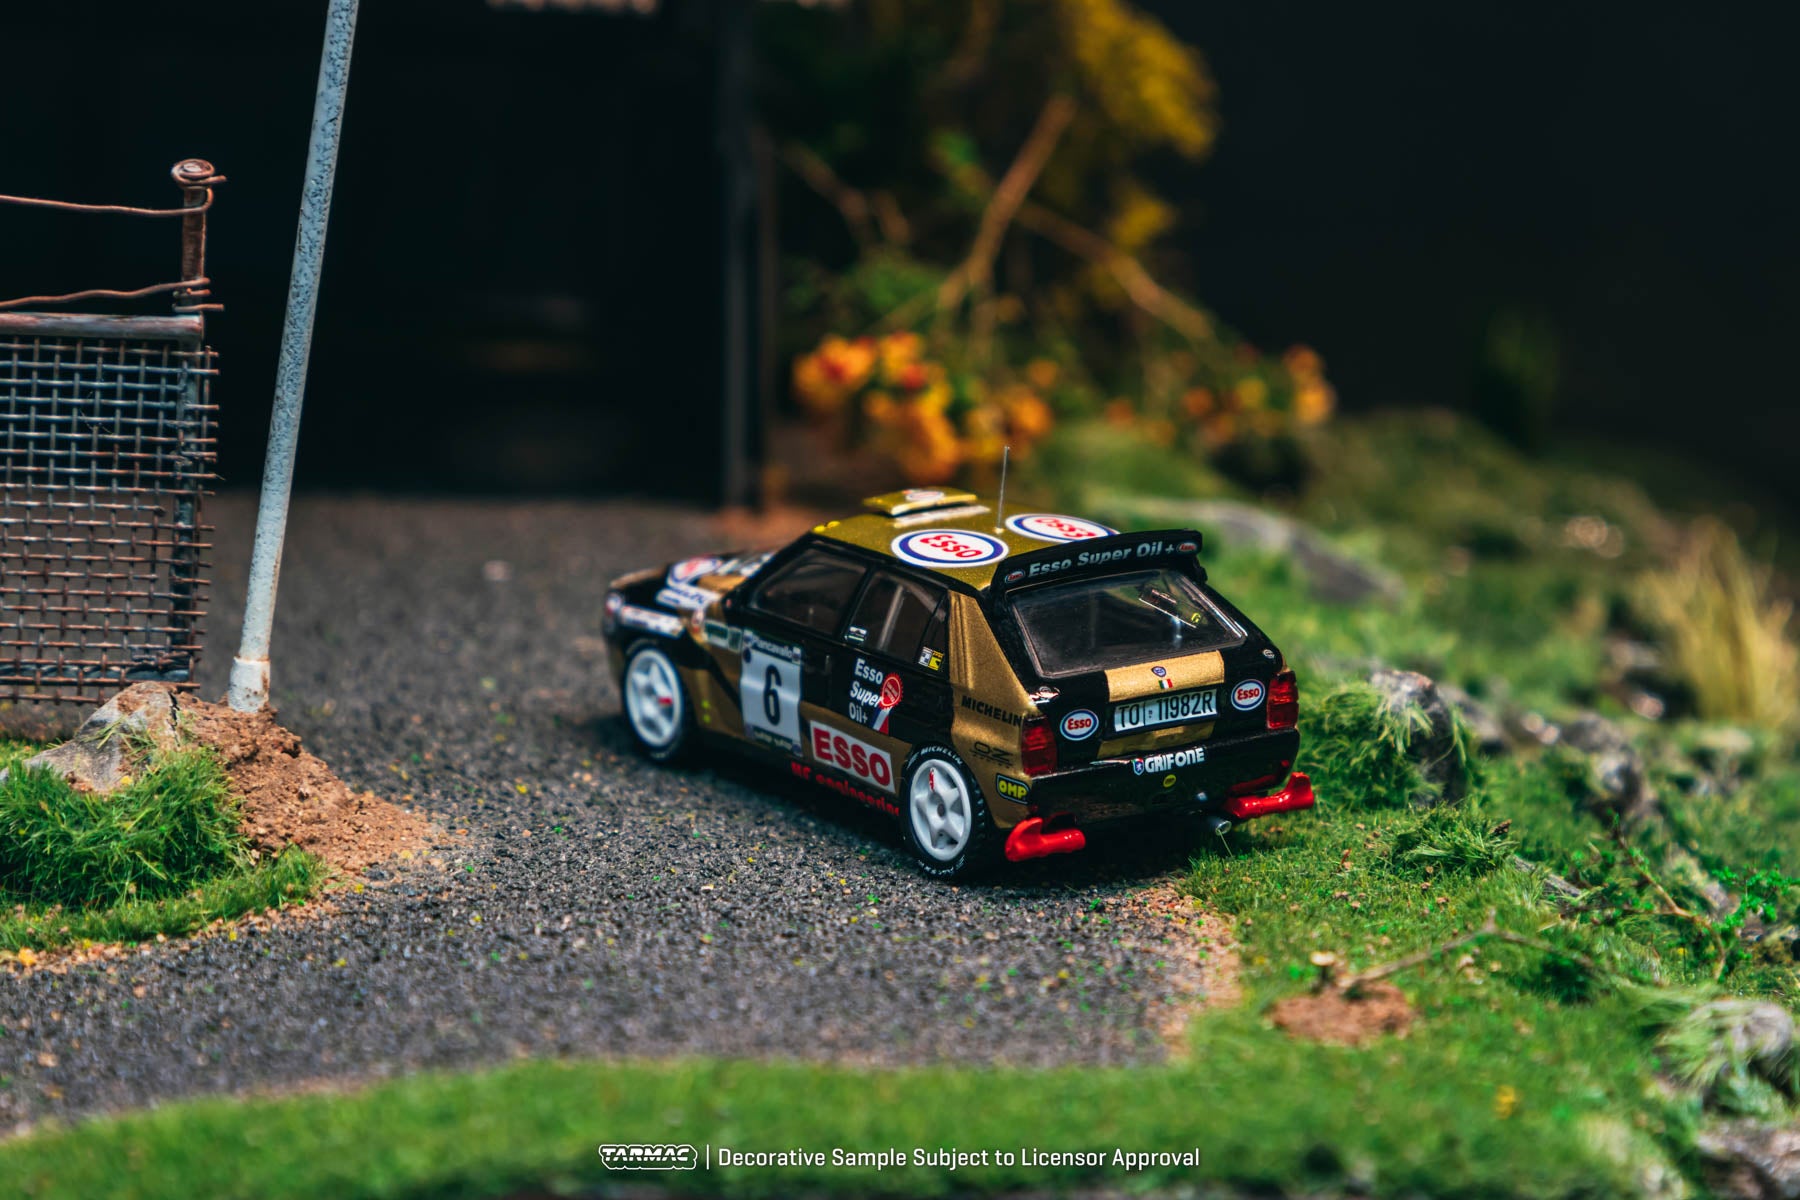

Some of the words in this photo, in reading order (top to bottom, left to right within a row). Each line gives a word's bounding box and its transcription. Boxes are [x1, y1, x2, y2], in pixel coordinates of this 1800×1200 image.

[1028, 561, 1072, 578] Esso
[1077, 547, 1133, 566] Super
[1136, 541, 1163, 557] Oil
[854, 657, 884, 685] Esso
[763, 663, 783, 726] 6
[849, 680, 884, 708] Super
[1236, 685, 1261, 700] Esso
[961, 694, 1022, 727] MICHELIN
[1118, 704, 1141, 728] TO
[1156, 690, 1215, 724] 11982R
[1066, 717, 1092, 731] Esso
[812, 726, 892, 787] ESSO
[920, 745, 963, 765] MICHELIN
[1143, 747, 1206, 773] GRIFONE
[998, 779, 1027, 799] OMP
